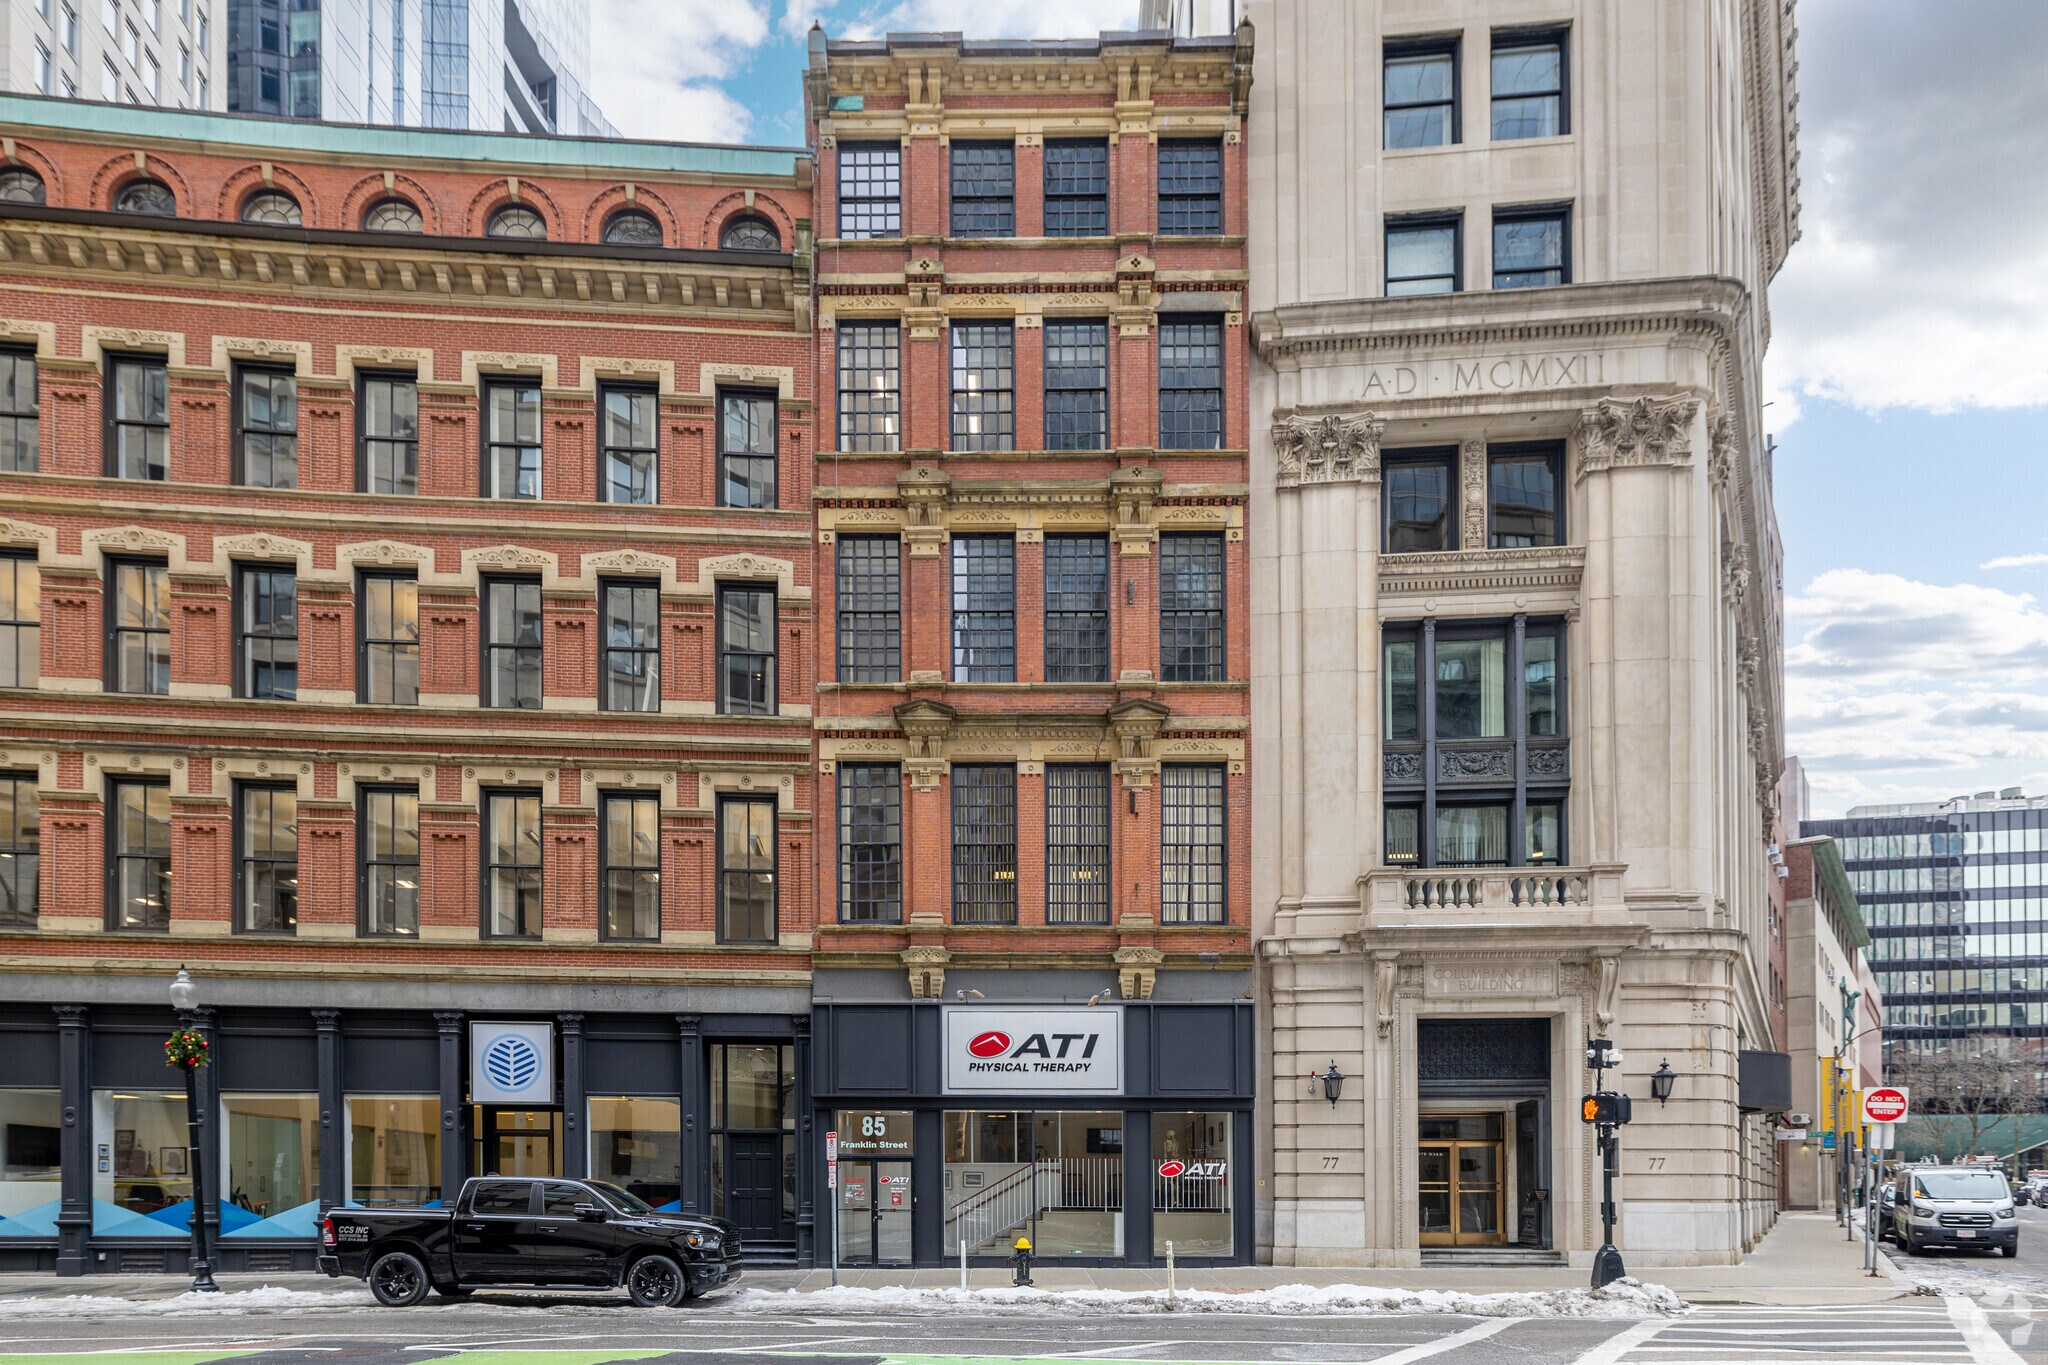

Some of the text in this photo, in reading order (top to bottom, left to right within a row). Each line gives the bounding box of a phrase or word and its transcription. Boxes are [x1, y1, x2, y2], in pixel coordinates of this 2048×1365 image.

[1454, 354, 1605, 392] MCMXII
[1433, 967, 1550, 980] COLUMBIAN LIFE
[1459, 979, 1523, 991] BUILDING
[1009, 1033, 1099, 1059] ATI
[968, 1062, 1092, 1072] PHYSICAL THERAPY
[861, 1115, 886, 1137] 85
[840, 1141, 908, 1149] Franklin Street
[1185, 1163, 1227, 1175] ATI
[1322, 1156, 1339, 1169] 77
[1648, 1157, 1665, 1170] 77
[338, 1225, 369, 1234] CCS INC
